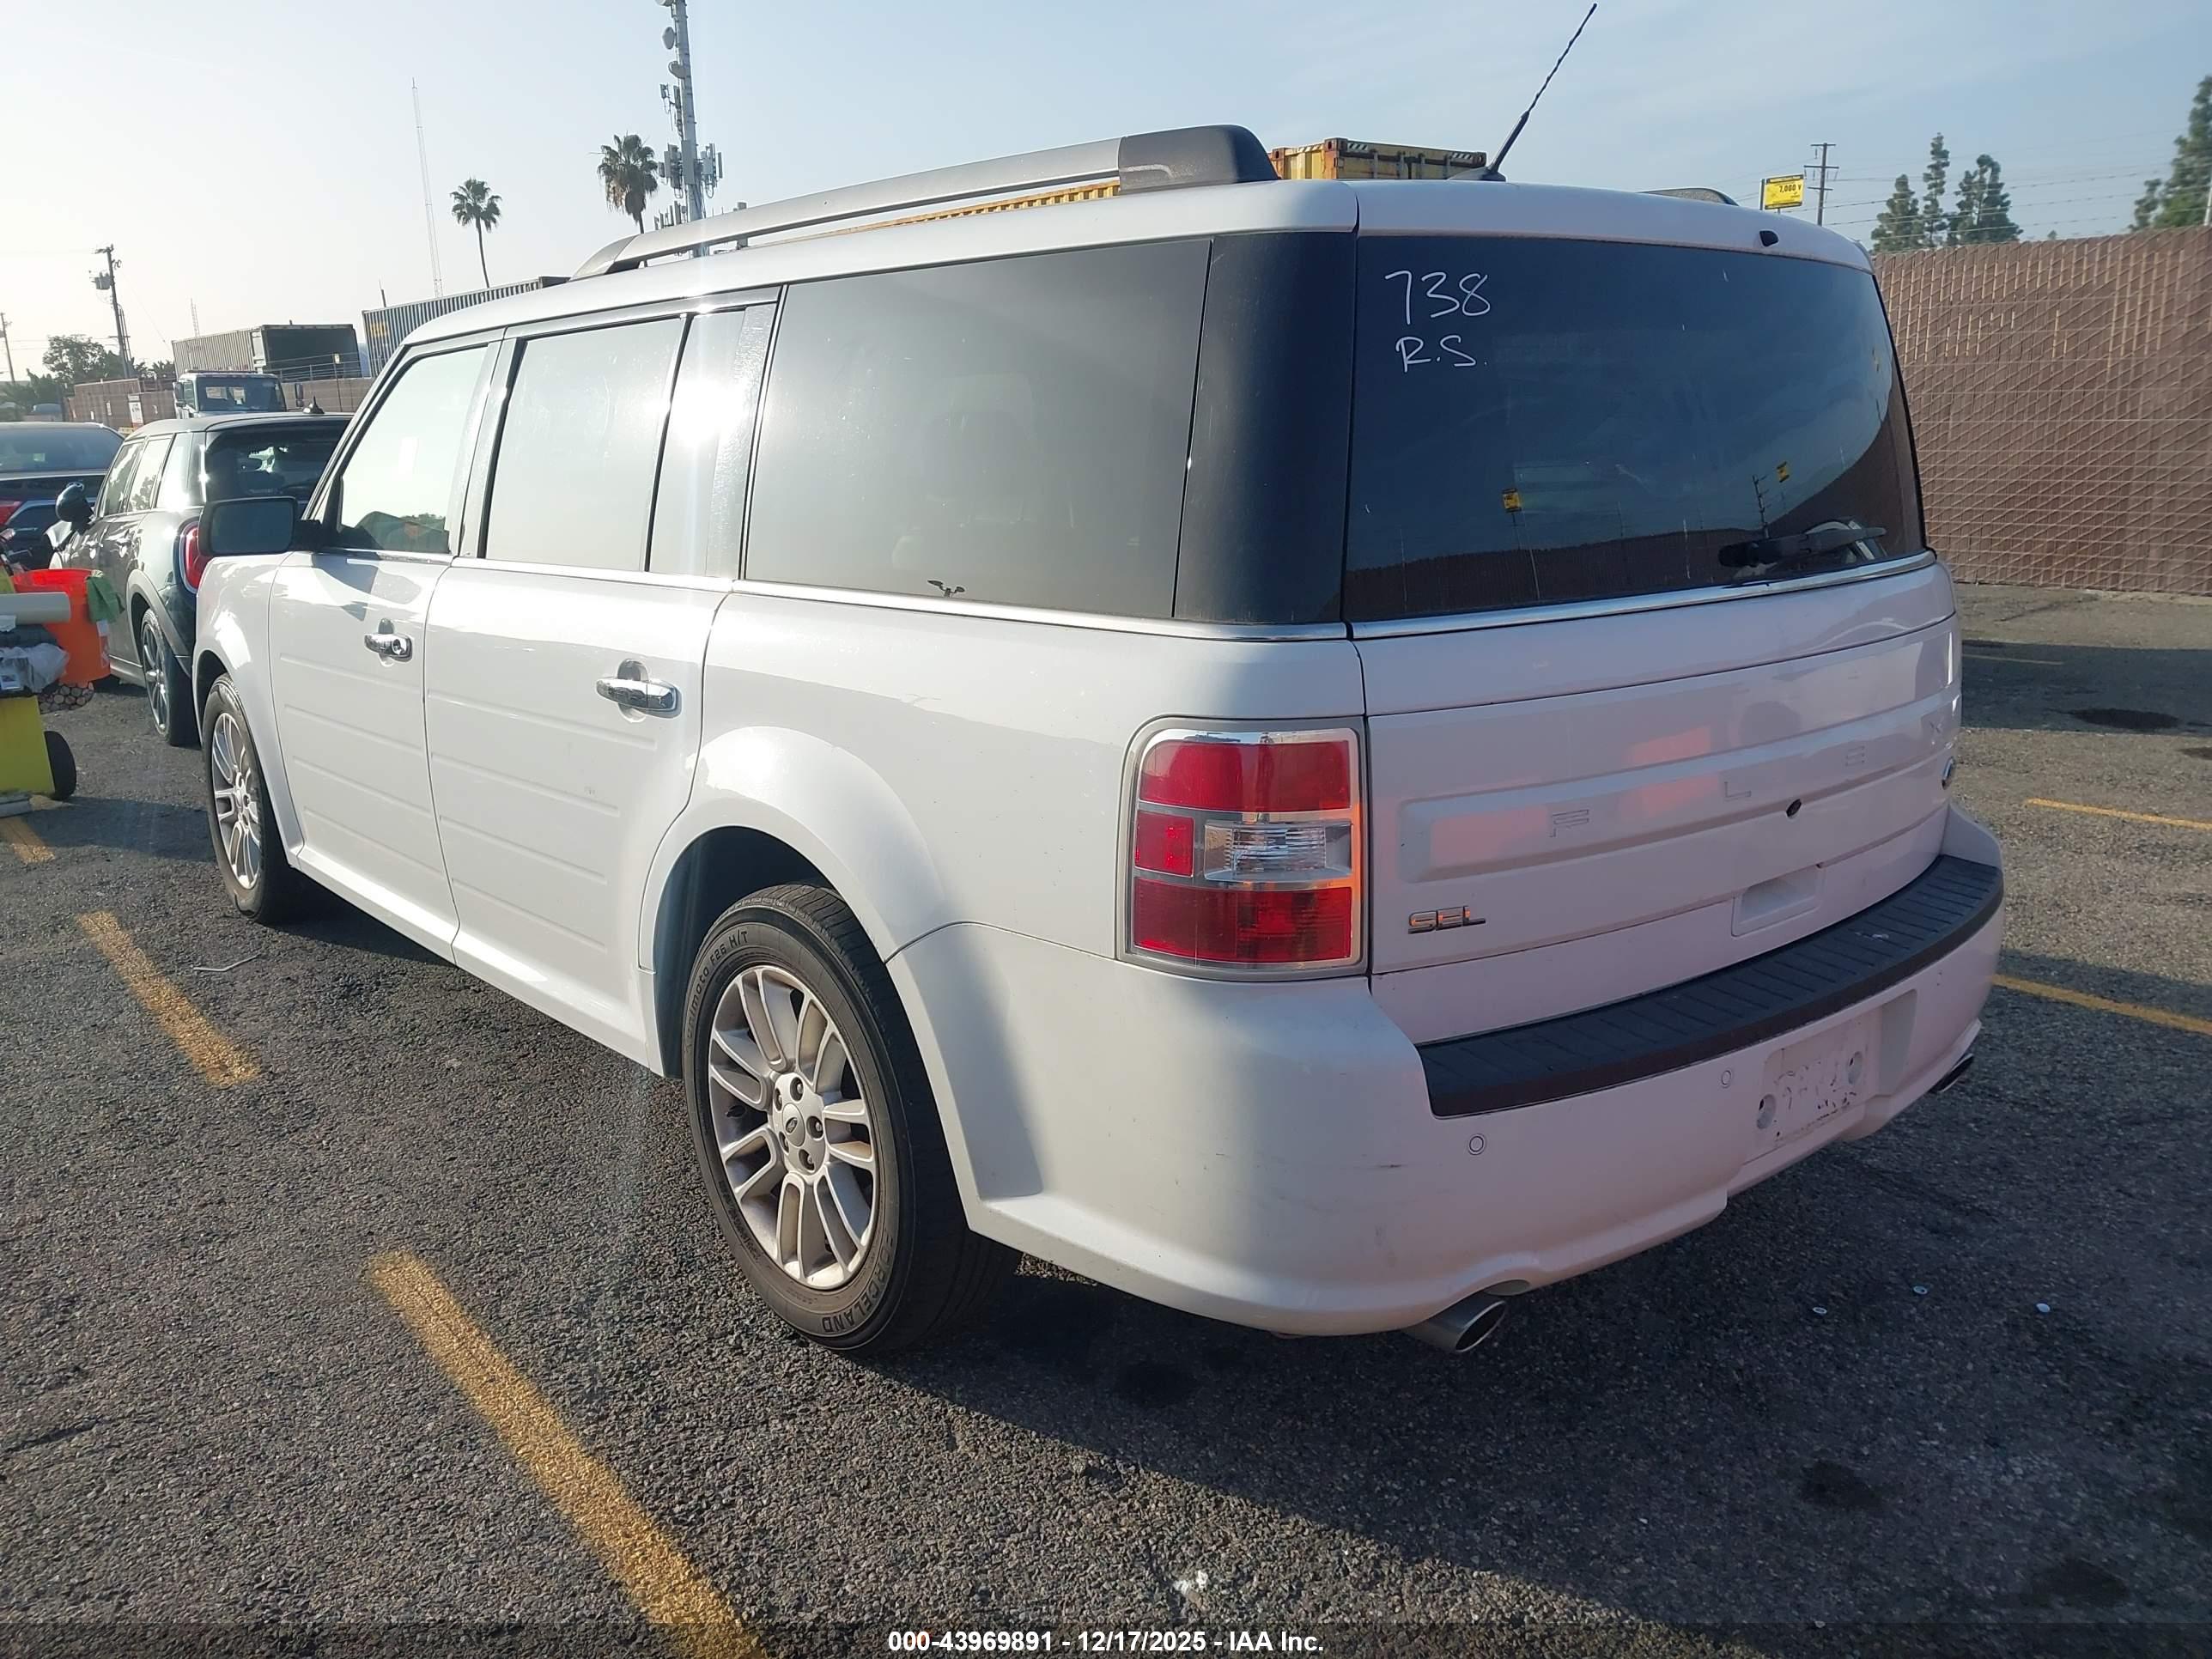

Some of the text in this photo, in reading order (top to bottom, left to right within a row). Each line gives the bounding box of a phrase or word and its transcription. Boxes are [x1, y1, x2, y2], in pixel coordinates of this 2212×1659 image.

[1384, 270, 1491, 325] 738
[1408, 905, 1486, 934] SEL
[709, 944, 727, 966] F26
[728, 929, 748, 949] H/T
[821, 1229, 894, 1334] FORCELAND
